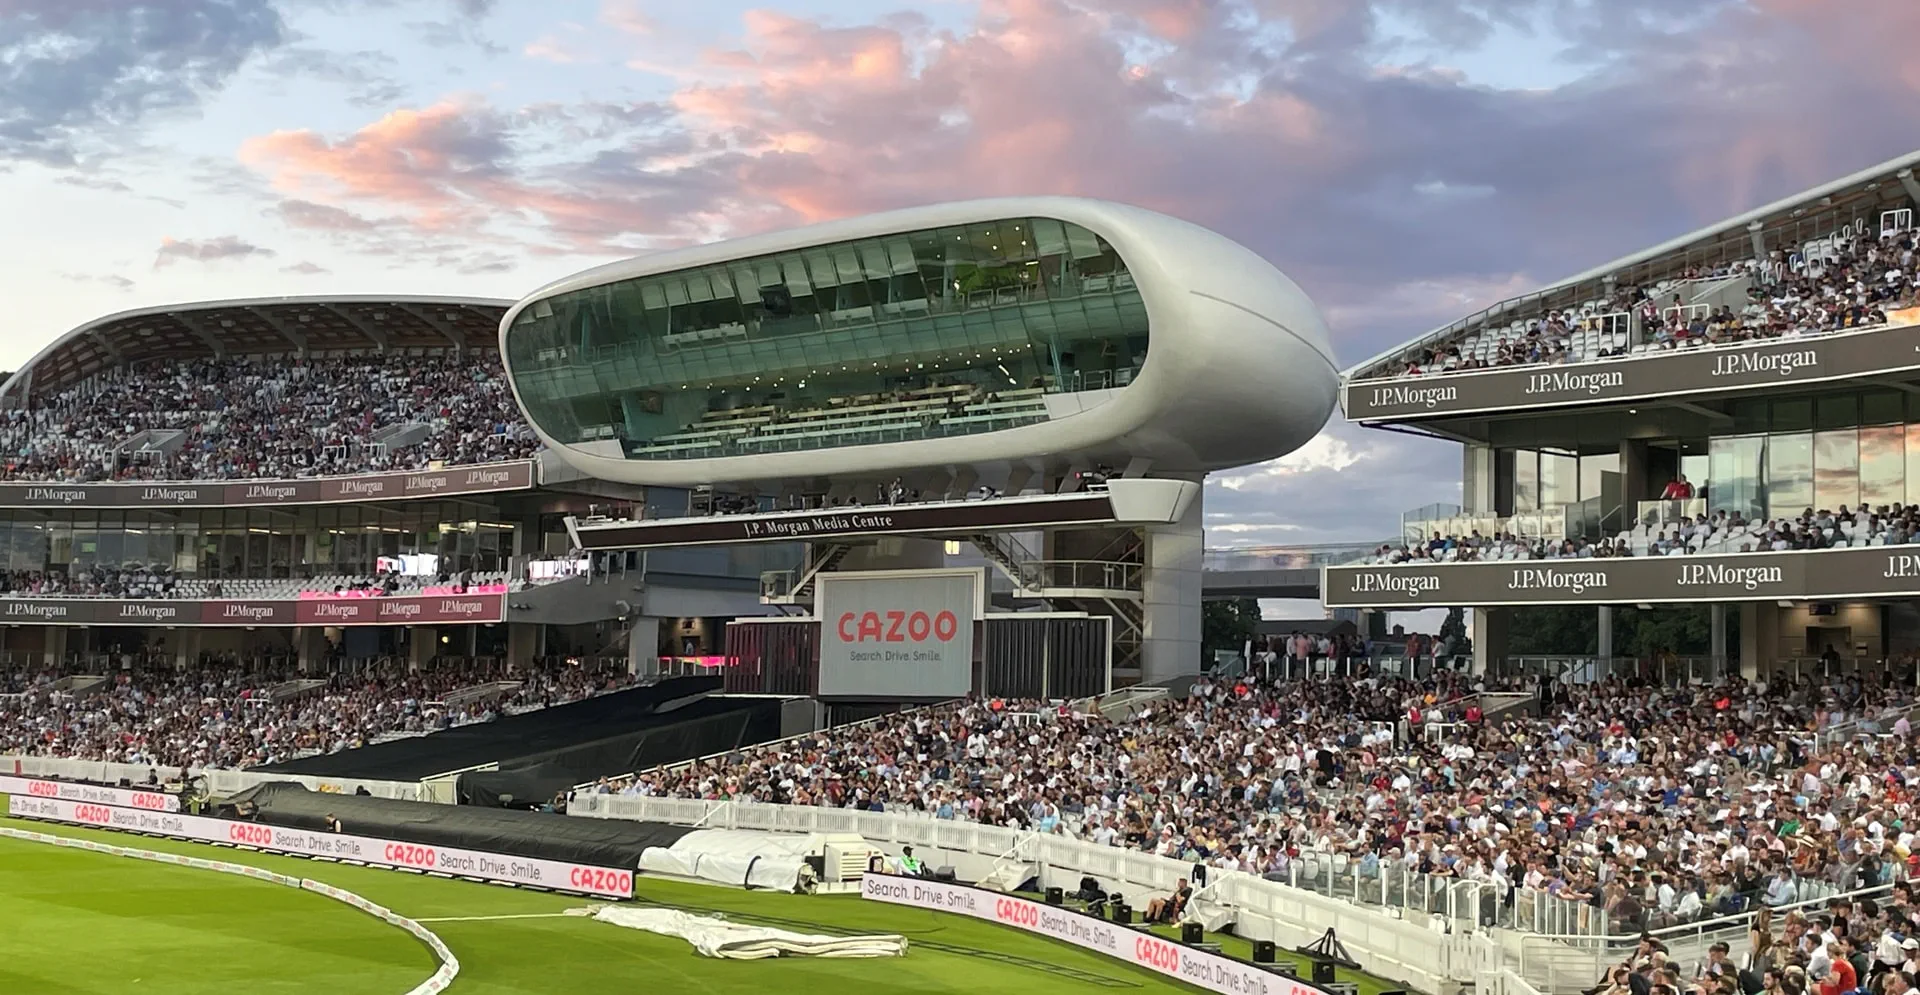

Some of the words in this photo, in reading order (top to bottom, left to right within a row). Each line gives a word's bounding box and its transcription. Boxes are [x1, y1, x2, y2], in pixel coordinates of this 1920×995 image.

[1712, 350, 1817, 375] J.P.Morgan
[1525, 371, 1624, 395] J.P.Morgan
[1369, 386, 1457, 408] J.P.Morgan
[406, 474, 447, 491] J.P.Morgan
[466, 470, 509, 486] J.P.Morgan
[25, 488, 86, 503] J.P.Morgan
[141, 488, 197, 503] J.P.Morgan
[246, 485, 296, 500] J.P.Morgan
[339, 480, 383, 496] J.P.Morgan
[744, 523, 764, 538] J.P.
[767, 521, 810, 536] Morgan
[812, 516, 850, 531] Media
[852, 514, 893, 529] Centre
[1351, 573, 1440, 597] J.P.Morgan
[1508, 569, 1607, 594] J.P.Morgan
[1677, 563, 1782, 590] J.P.Morgan
[5, 603, 67, 619] J.P.Morgan
[120, 604, 176, 620] J.P.Morgan
[223, 604, 273, 620] J.P.Morgan
[315, 604, 358, 620] J.P.Morgan
[380, 602, 421, 619] J.P.Morgan
[439, 600, 482, 616] J.P.Morgan
[838, 610, 957, 642] CAZOO
[28, 781, 58, 796] CAZOO
[132, 793, 165, 809] CAZOO
[75, 805, 110, 823] CAZOO
[230, 824, 272, 845] CAZOO
[275, 832, 306, 849] Search.
[335, 840, 362, 856] Smile.
[385, 844, 436, 867] CAZOO
[440, 853, 477, 871] Search.
[479, 859, 509, 876] Drive.
[510, 863, 543, 881] Smile.
[570, 867, 631, 893] CAZOO
[867, 880, 910, 900] Search.
[914, 885, 945, 905] Drive.
[947, 891, 977, 911] Smile.
[996, 899, 1039, 927] CAZOO
[1041, 912, 1069, 934] Search.
[1071, 919, 1093, 941] Drive.
[1093, 926, 1117, 950] Smile.
[1135, 937, 1178, 972] CAZOO
[1182, 954, 1215, 981] Search.
[1216, 964, 1242, 991] Drive.
